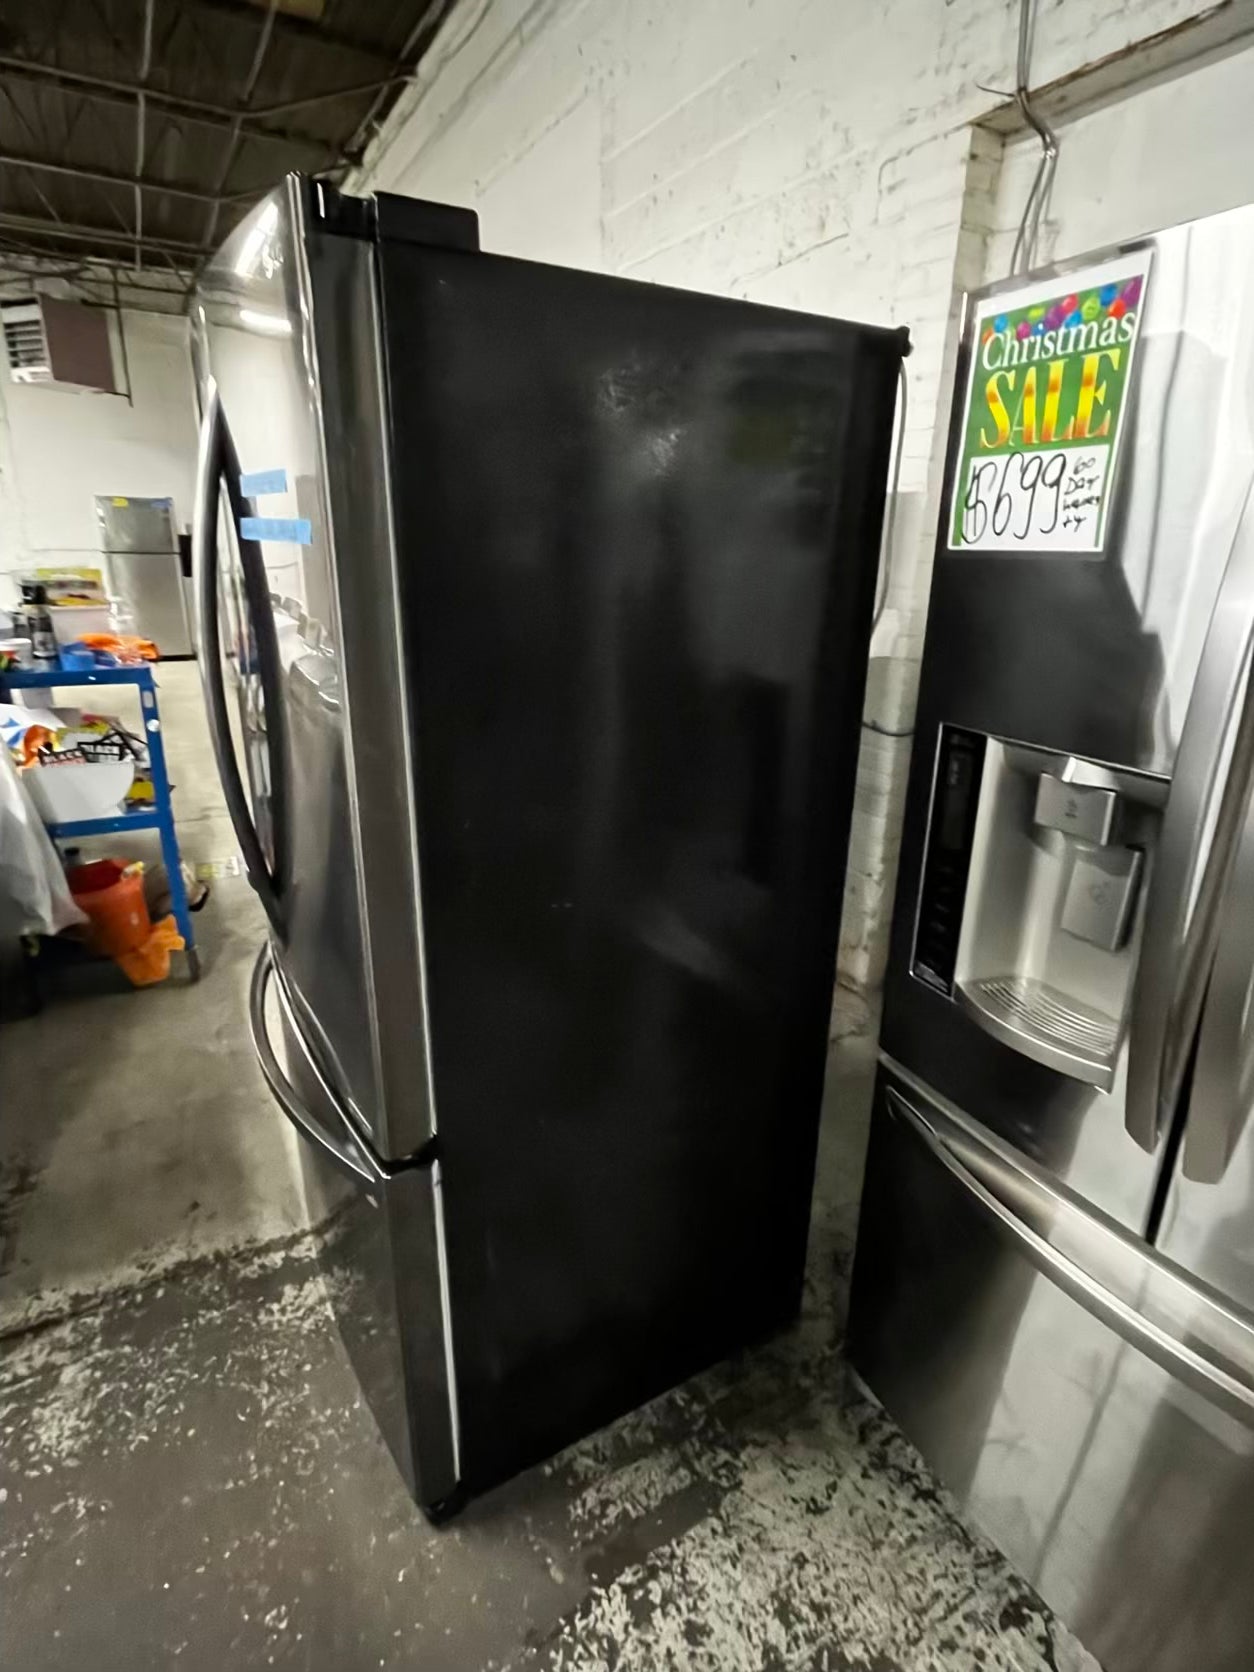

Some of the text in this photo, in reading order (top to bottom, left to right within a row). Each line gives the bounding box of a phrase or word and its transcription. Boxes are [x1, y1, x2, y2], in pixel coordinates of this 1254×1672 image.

[982, 312, 1136, 371] Christmas
[980, 348, 1121, 449] SALE
[961, 451, 1067, 544] $699
